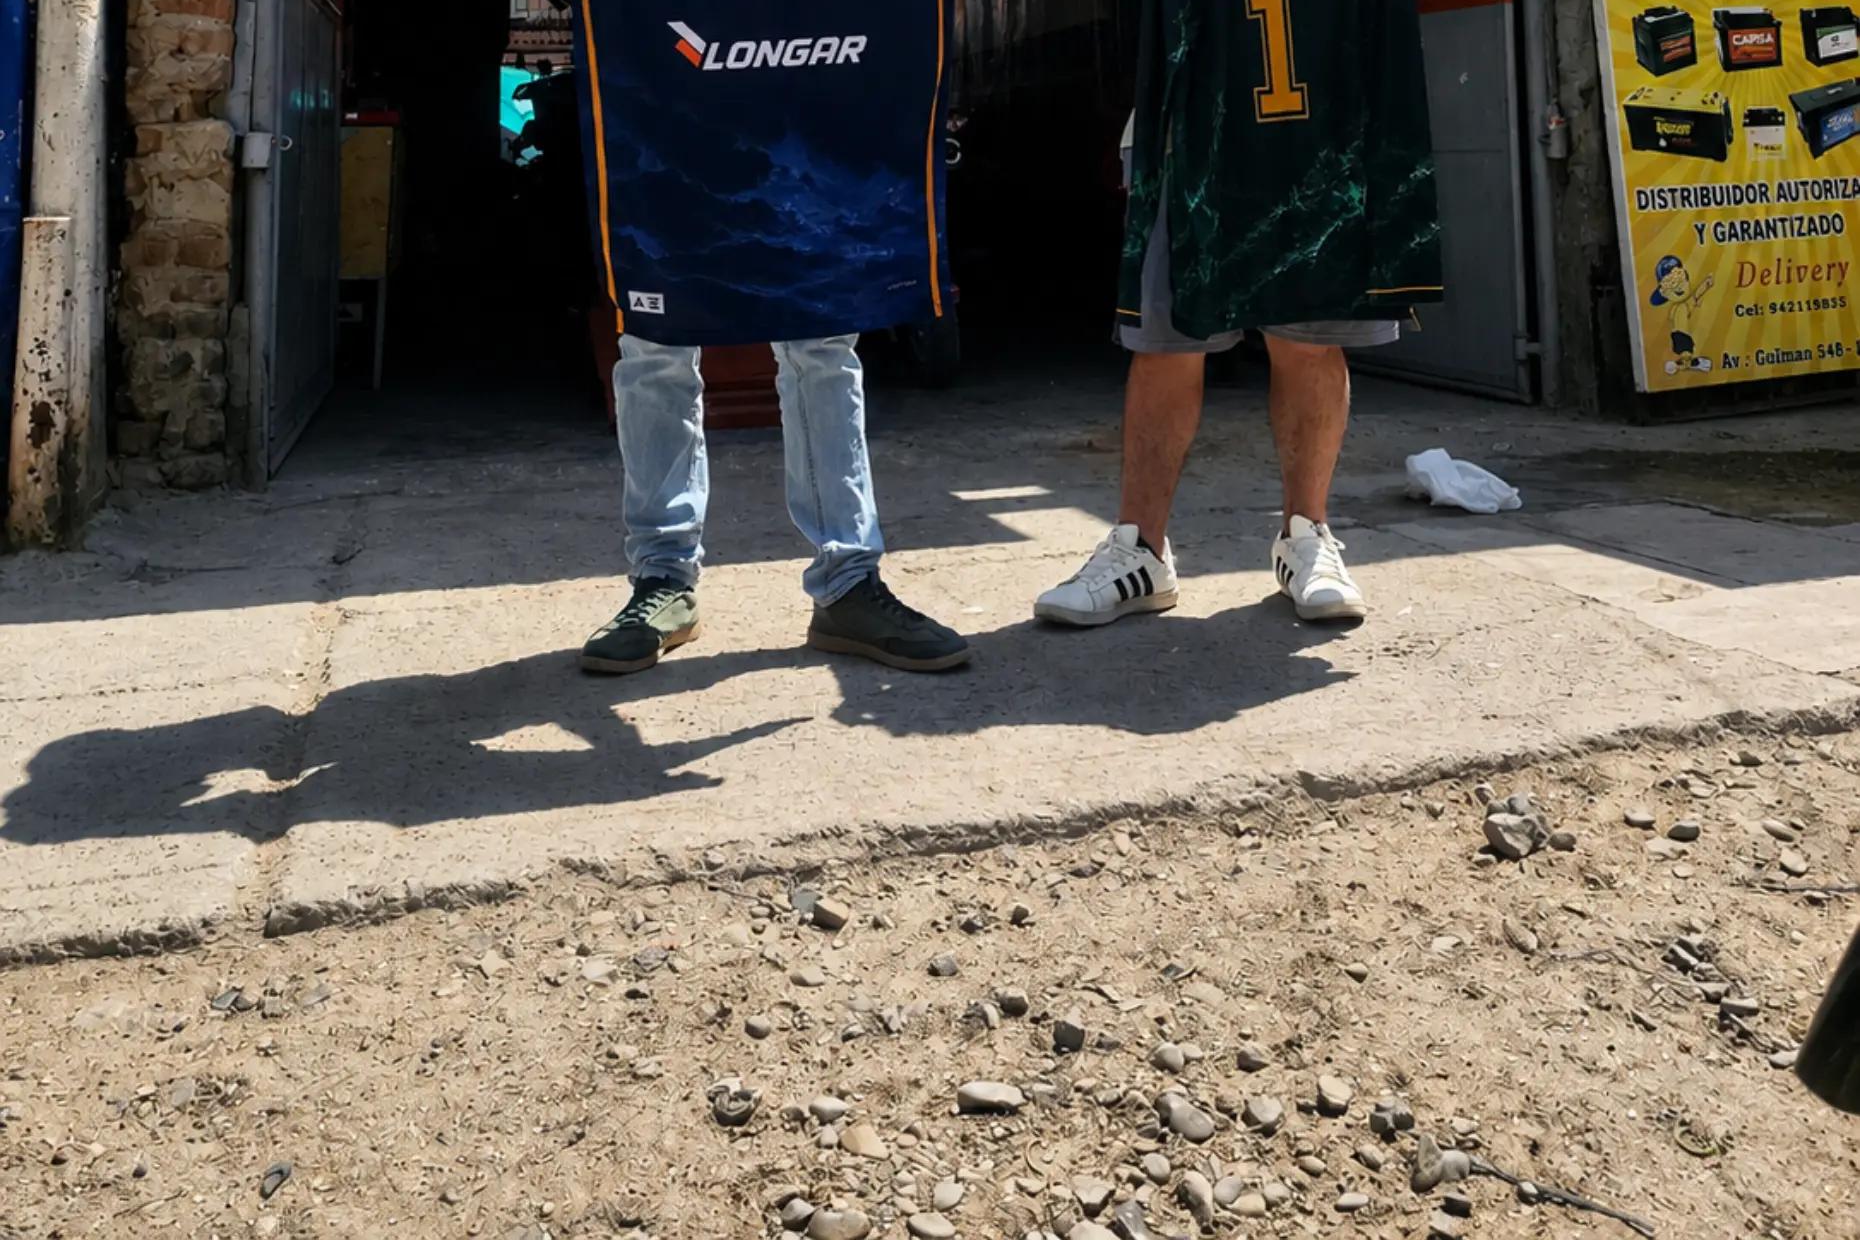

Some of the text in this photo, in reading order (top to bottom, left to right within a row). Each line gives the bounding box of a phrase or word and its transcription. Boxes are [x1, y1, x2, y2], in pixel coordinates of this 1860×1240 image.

[702, 35, 868, 71] LONGAR
[1636, 182, 1770, 210] DISTRIBUIDOR
[1695, 213, 1845, 245] Y GARANTIZADO
[1736, 258, 1849, 289] Delivery
[1735, 304, 1764, 317] Cel:
[1755, 348, 1812, 366] Gulman
